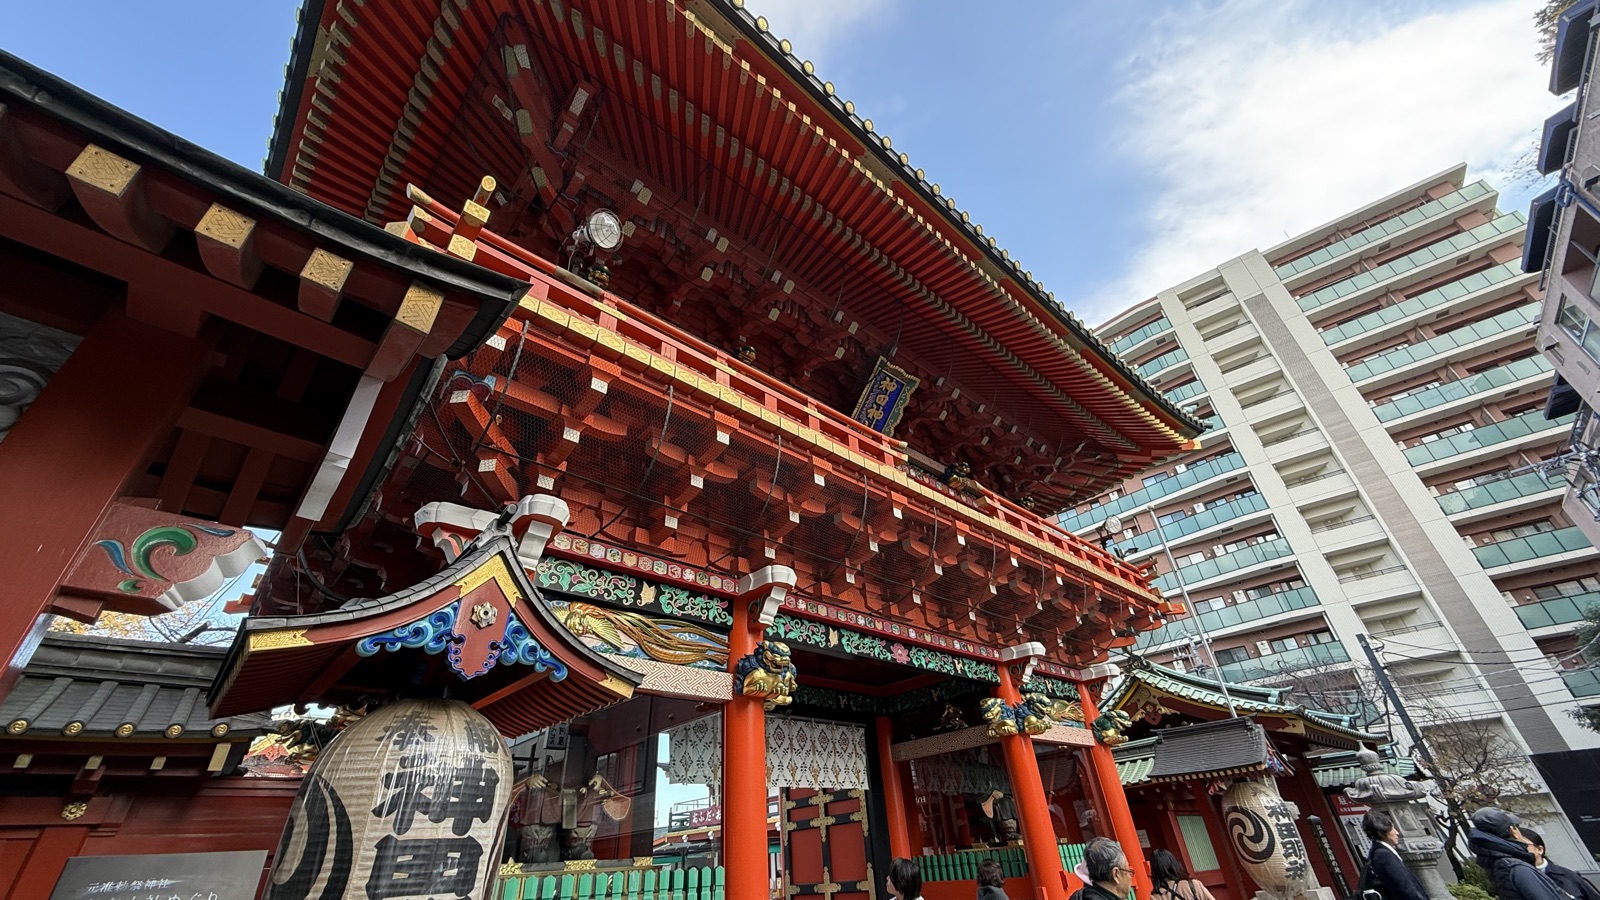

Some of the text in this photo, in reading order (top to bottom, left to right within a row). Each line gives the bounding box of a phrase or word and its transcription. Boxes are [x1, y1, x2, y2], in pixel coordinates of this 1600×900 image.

[865, 376, 897, 429] 神田神
[365, 752, 501, 900] 神田
